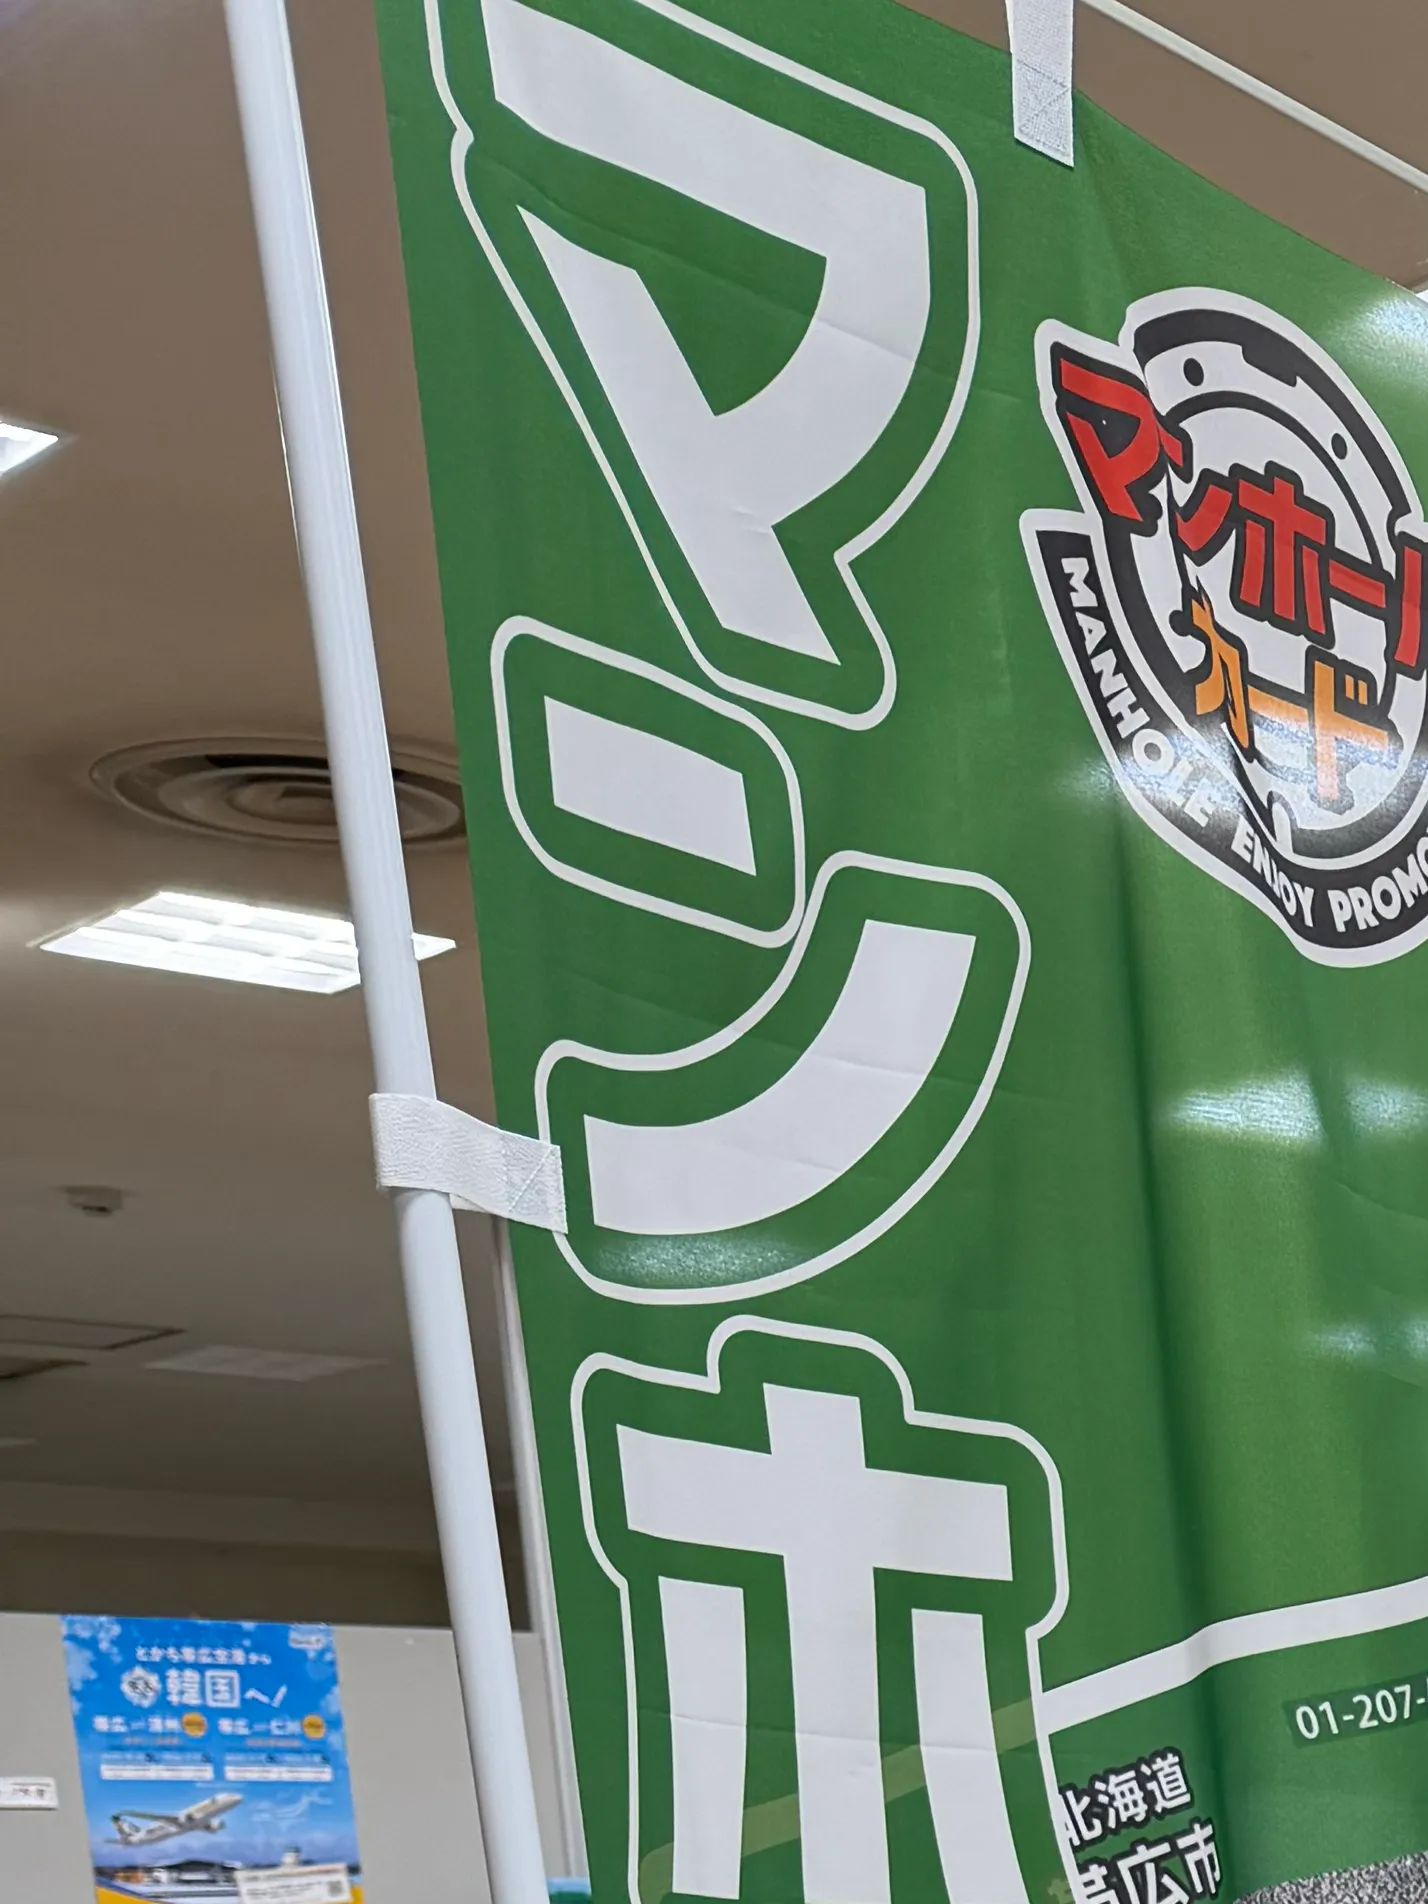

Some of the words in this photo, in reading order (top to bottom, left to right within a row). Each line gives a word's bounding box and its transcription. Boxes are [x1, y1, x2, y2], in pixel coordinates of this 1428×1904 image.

[1060, 556, 1213, 829] MANHOLE
[1230, 825, 1315, 931] ENJOY
[1191, 598, 1390, 802] カード
[1060, 1752, 1192, 1848] 北海道
